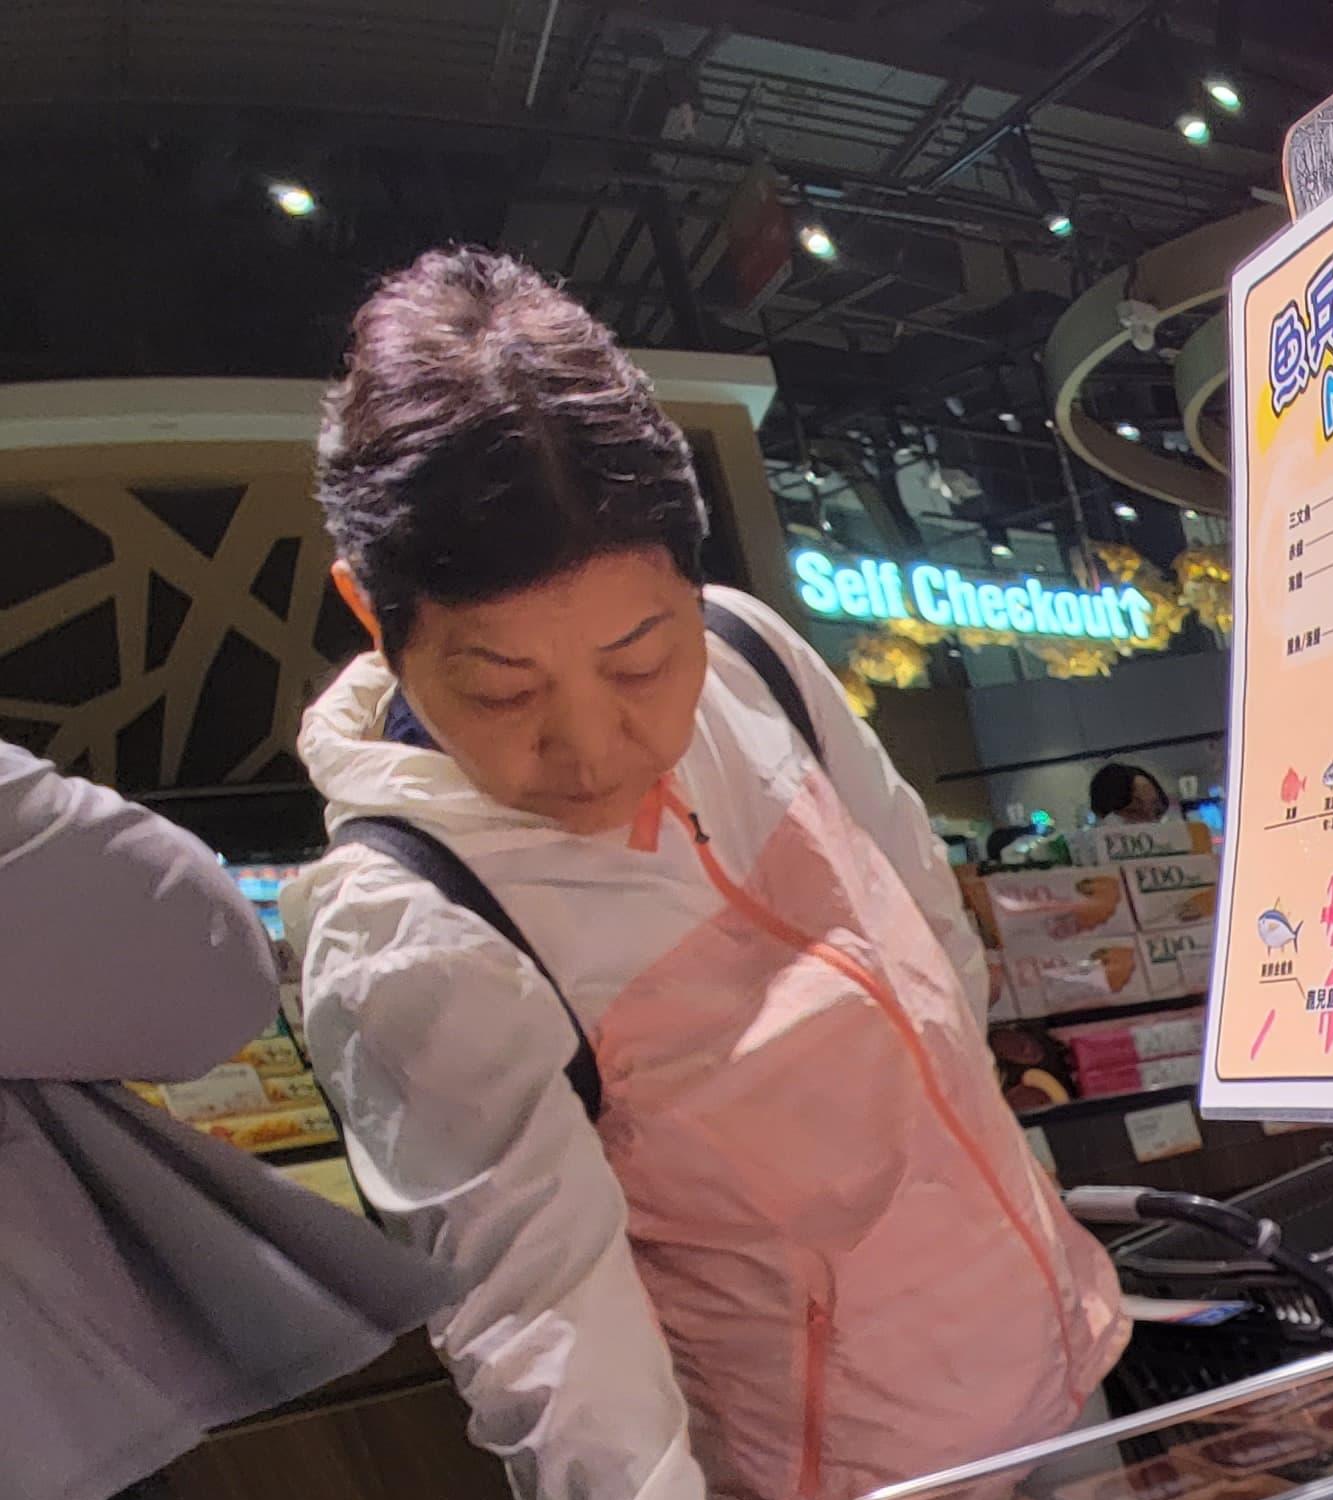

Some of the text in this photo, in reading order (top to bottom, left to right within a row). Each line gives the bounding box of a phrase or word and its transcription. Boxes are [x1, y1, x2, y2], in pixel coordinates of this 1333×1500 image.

[1289, 504, 1311, 529] 三文魚
[795, 551, 1130, 638] Self Checkout
